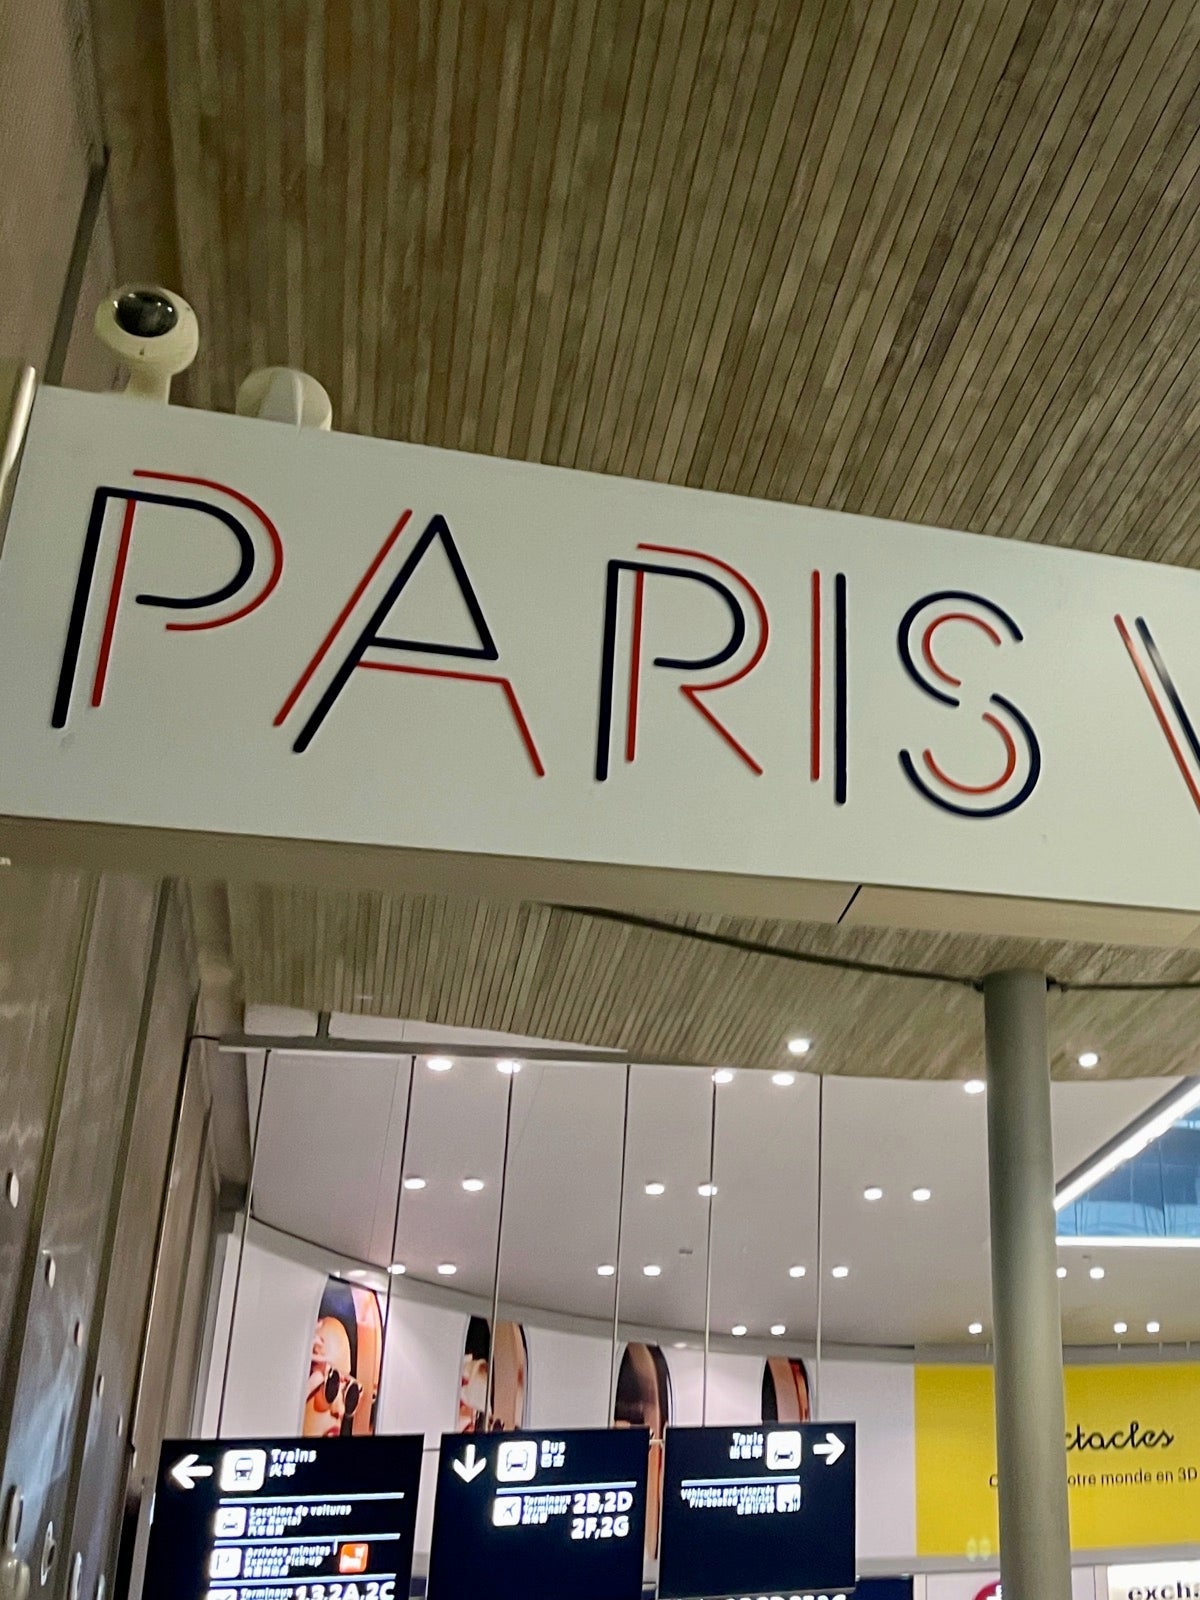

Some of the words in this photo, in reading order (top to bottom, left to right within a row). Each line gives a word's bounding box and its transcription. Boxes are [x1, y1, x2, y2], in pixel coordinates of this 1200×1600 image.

[51, 469, 1041, 818] PARIS
[732, 1432, 764, 1446] Taxis
[1066, 1420, 1174, 1451] ctacles
[270, 1448, 317, 1463] Trains
[541, 1440, 566, 1454] Bus
[1067, 1473, 1096, 1487] otre
[1100, 1467, 1151, 1486] monde
[1156, 1471, 1173, 1482] en
[1177, 1466, 1198, 1482] 3D
[249, 1505, 294, 1517] Location
[294, 1504, 309, 1517] de
[310, 1503, 352, 1516] voitures
[572, 1491, 634, 1514] 2B,2D
[570, 1515, 630, 1540] 2F,2G
[290, 1545, 331, 1557] minutes
